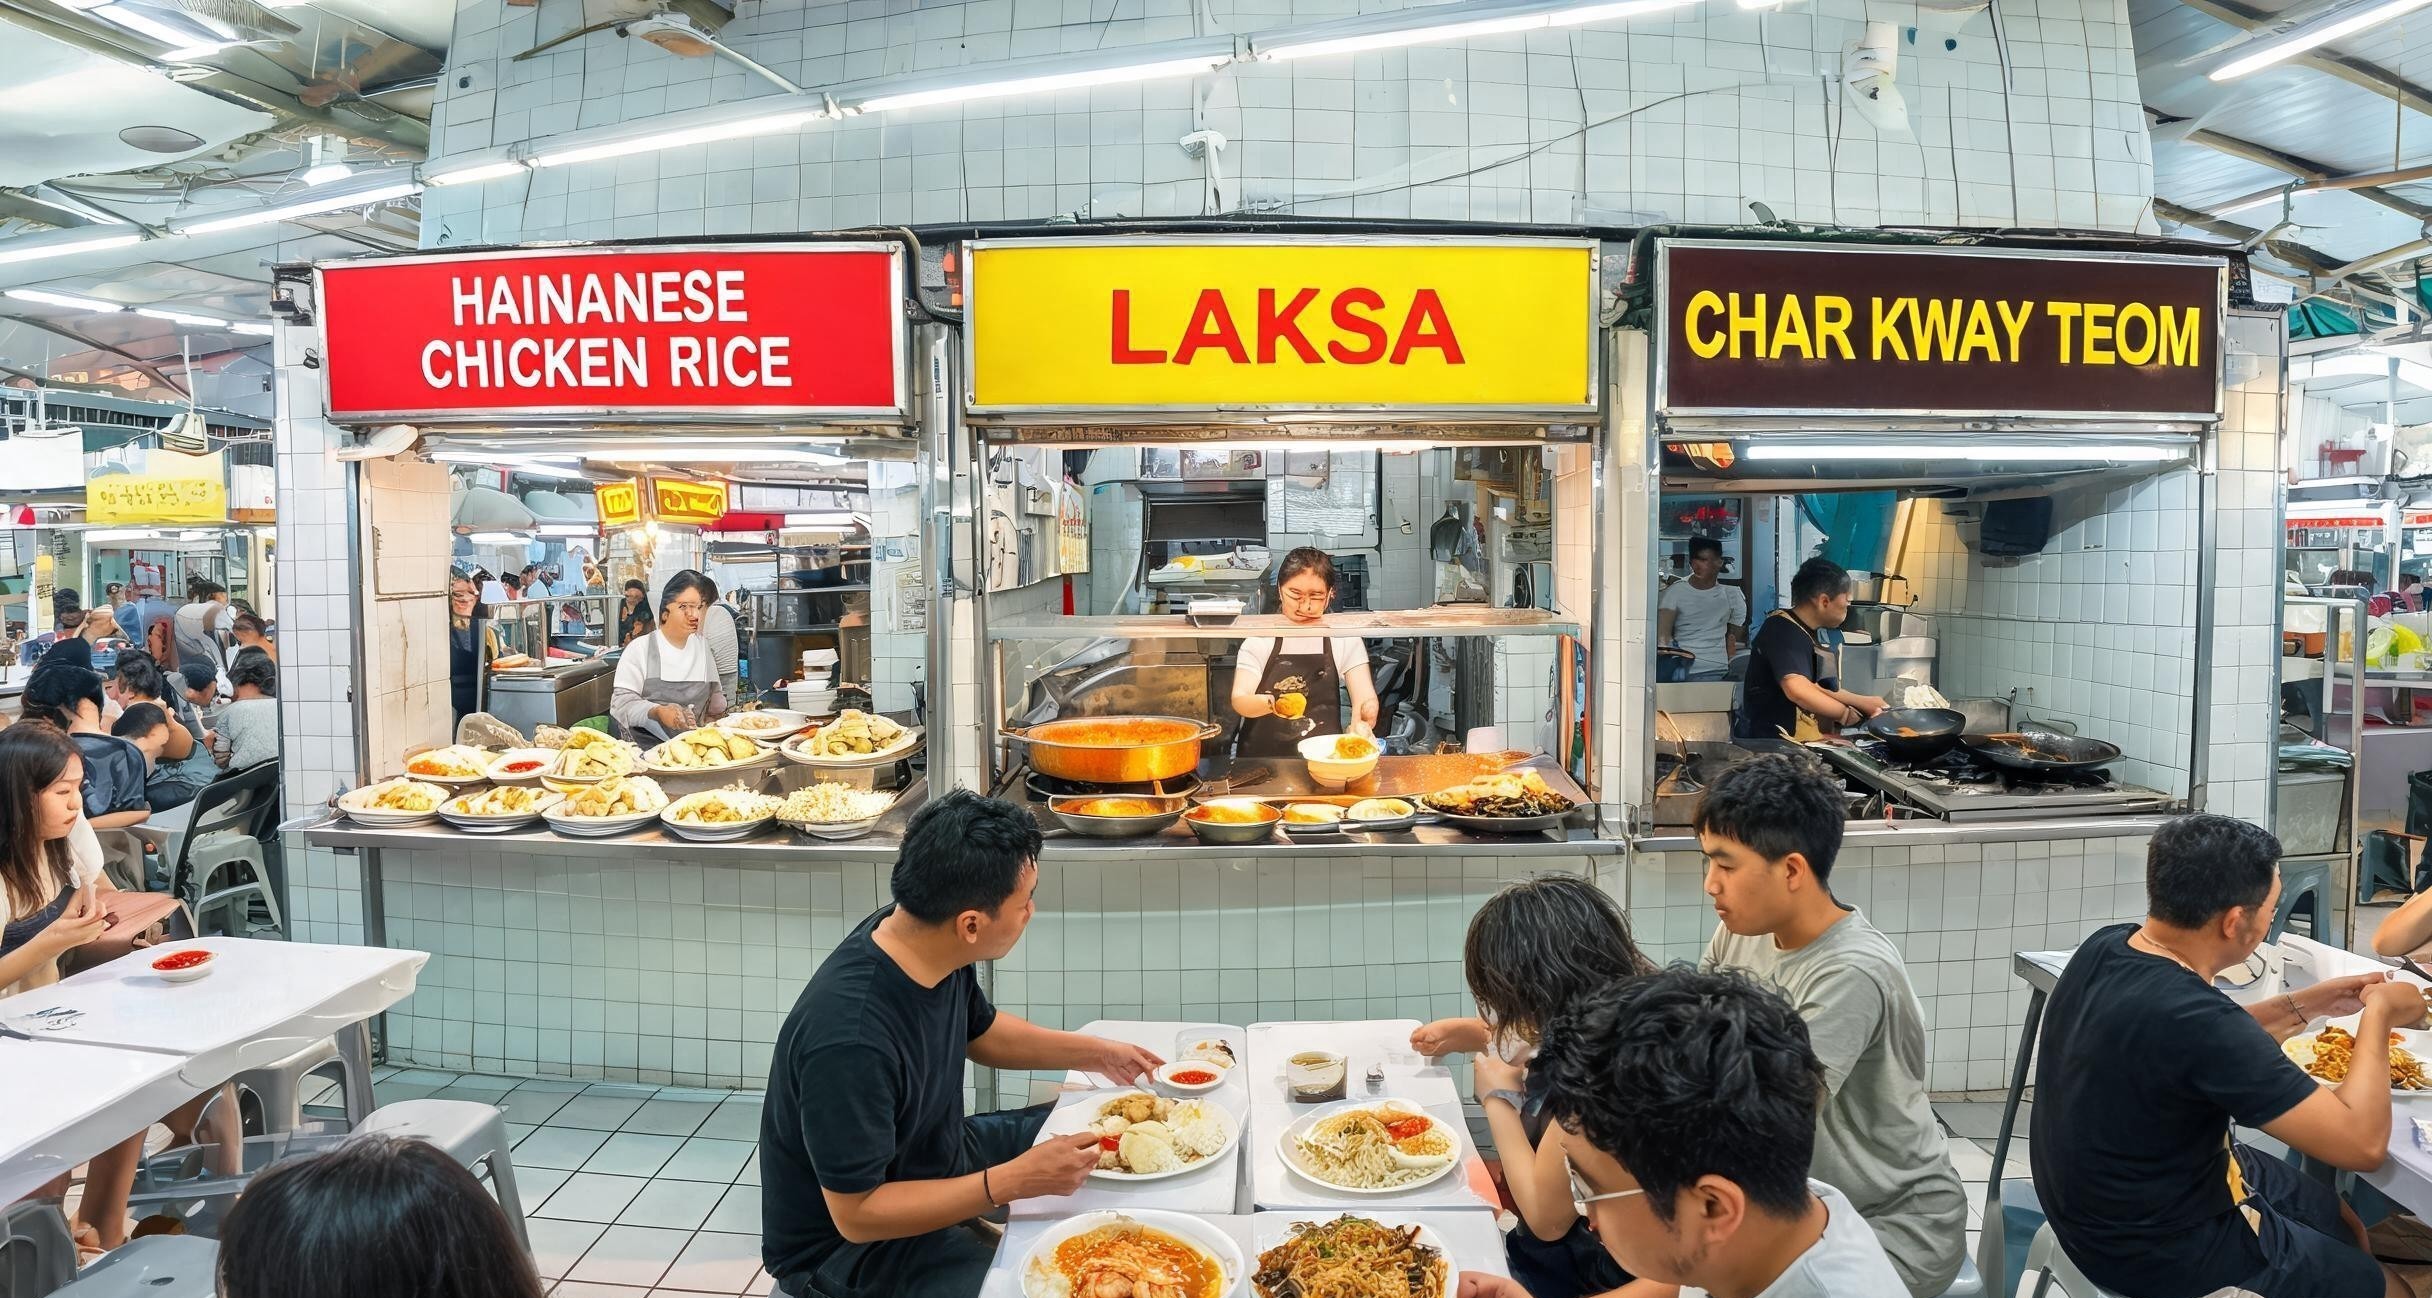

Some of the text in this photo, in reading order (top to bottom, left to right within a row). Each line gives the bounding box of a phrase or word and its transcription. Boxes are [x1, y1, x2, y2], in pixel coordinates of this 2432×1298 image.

[451, 271, 748, 326] HAINANESE
[1110, 287, 1467, 367] LAKSA
[1685, 289, 2201, 367] CHAR KWAY TEOM
[421, 335, 794, 389] CHICKEN RICE
